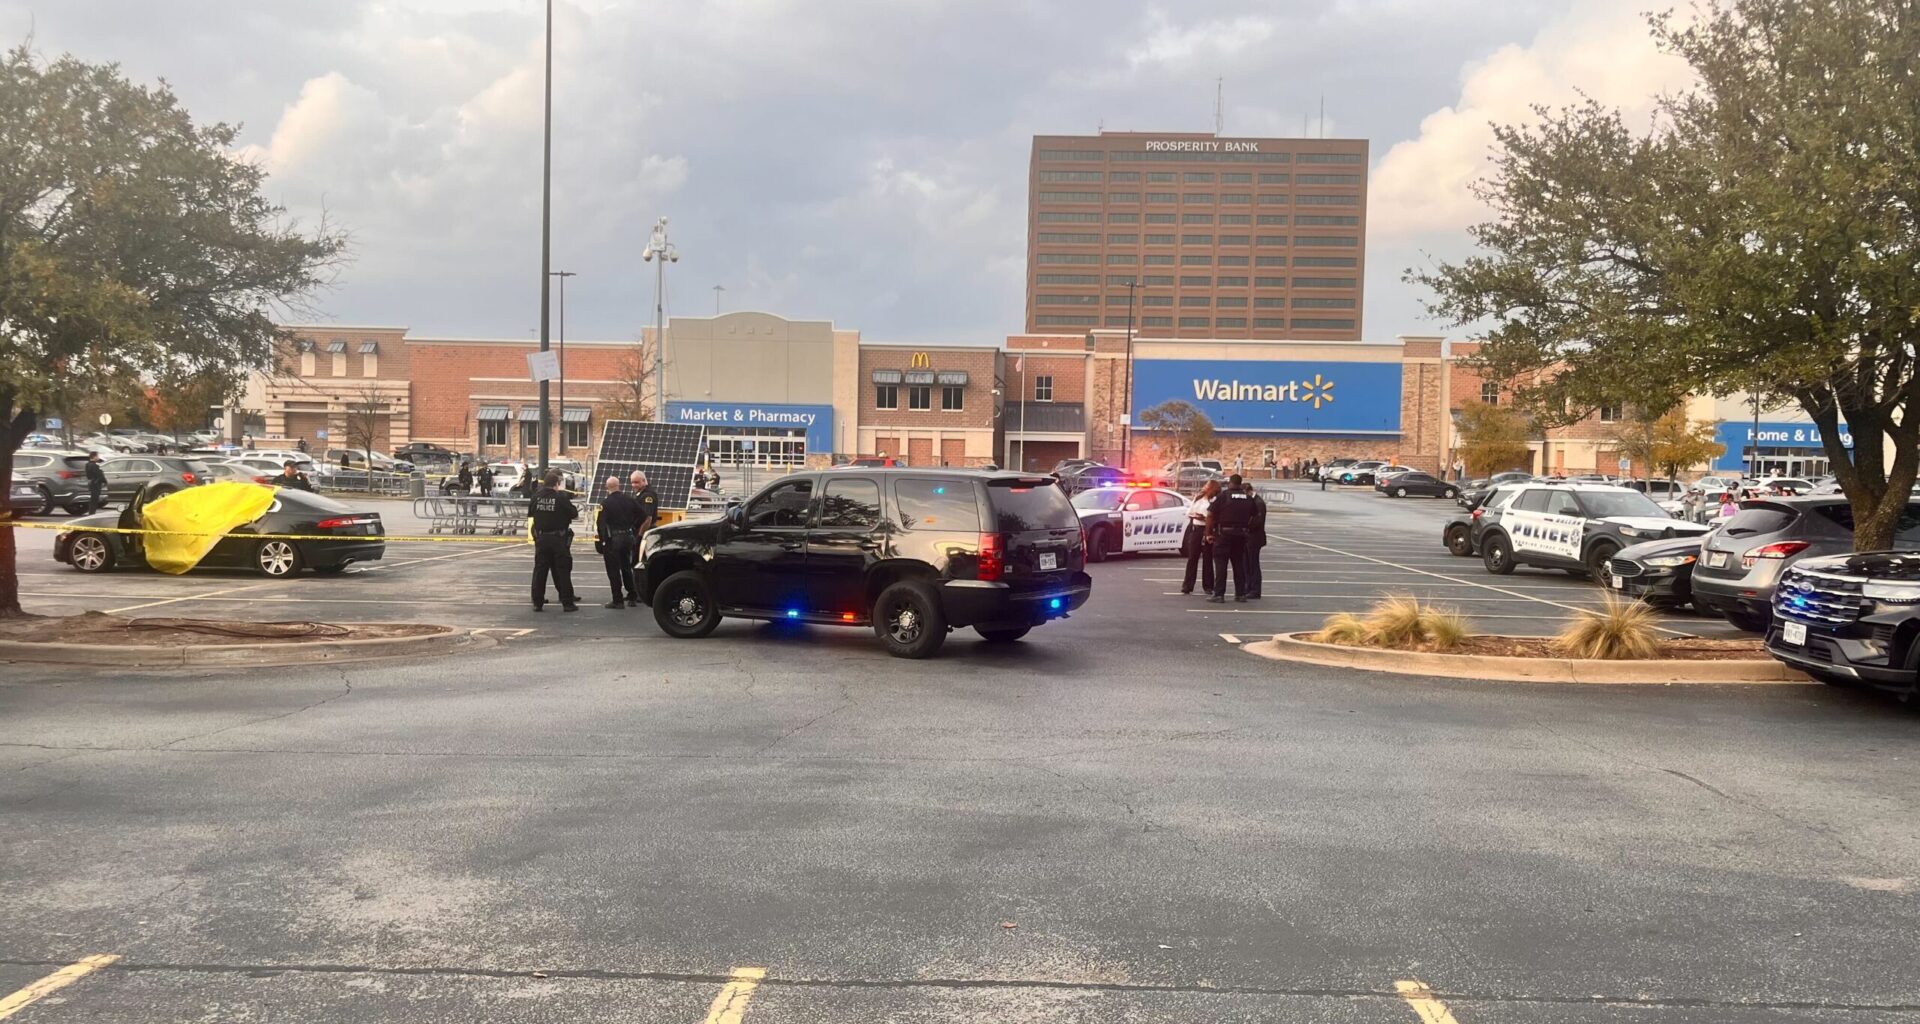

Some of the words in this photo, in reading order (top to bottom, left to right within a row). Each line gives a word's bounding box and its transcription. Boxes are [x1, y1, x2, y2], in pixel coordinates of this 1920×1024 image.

[1146, 141, 1219, 152] PROSPERITY
[1225, 142, 1258, 151] BANK
[1193, 379, 1298, 401] Walmart
[680, 408, 727, 421] Market
[734, 409, 743, 421] &
[749, 410, 815, 425] Pharmacy
[1747, 428, 1789, 441] Home
[1794, 429, 1805, 441] &
[1134, 522, 1183, 535] POLICE
[1512, 524, 1568, 544] POLICE
